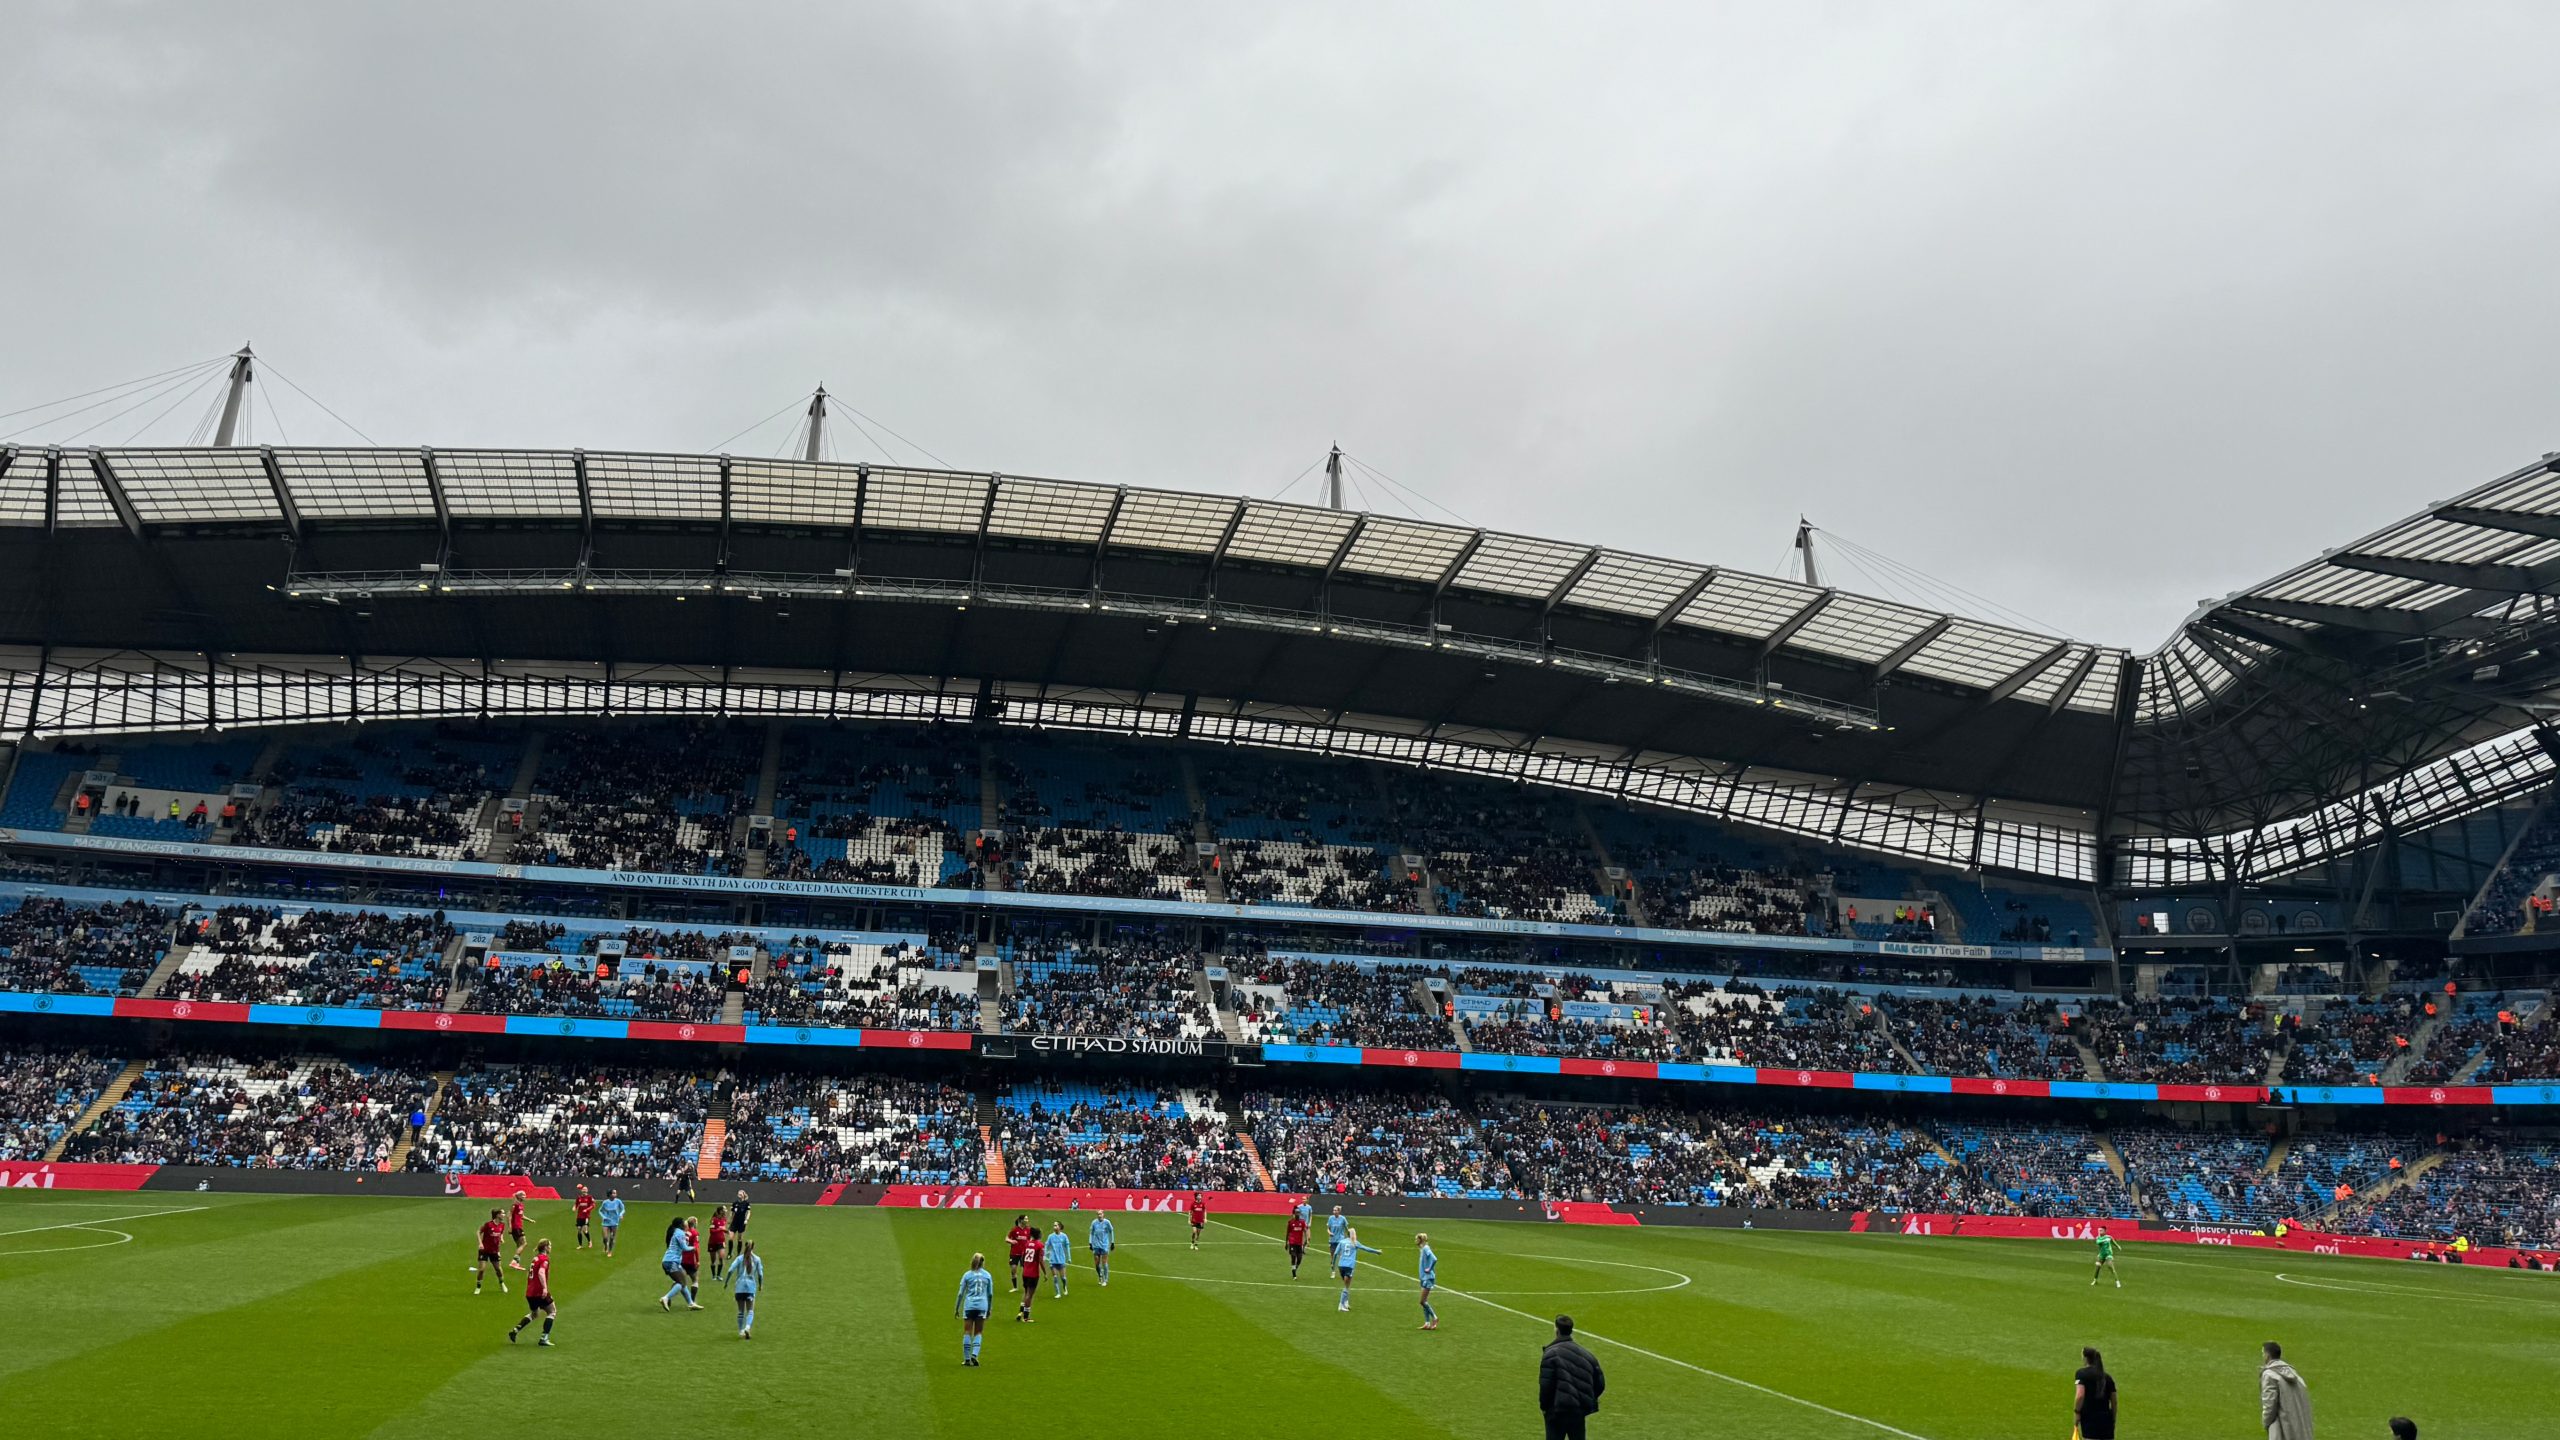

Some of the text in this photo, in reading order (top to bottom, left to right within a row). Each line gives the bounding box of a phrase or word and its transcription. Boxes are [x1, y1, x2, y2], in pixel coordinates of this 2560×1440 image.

[73, 837, 184, 854] MADE IN MANCHESTER
[209, 848, 269, 861] IMPECCABLE
[271, 852, 313, 863] SUPPORT
[315, 855, 345, 865] SINCE
[391, 860, 455, 872] LIVE FOR CITY
[610, 873, 927, 898] AND ON THE SIXTH DAY GOD CREATED MANCHESTER CITY
[1250, 908, 1276, 916] SHEIKH
[1312, 911, 1359, 921] MANCHESTER
[1359, 914, 1387, 922] THANKS
[1388, 915, 1403, 923] YOU
[1427, 918, 1450, 926] GREAT
[1450, 919, 1473, 927] YEARS
[472, 936, 487, 944] 202
[1662, 929, 1674, 937] The
[1788, 937, 1829, 946] Manchester
[1883, 942, 1986, 957] MAN CITY True Faith
[497, 955, 532, 963] TIHAD
[1429, 980, 1441, 988] 207
[1031, 1036, 1203, 1055] ETIHAD STADIUM
[1024, 1248, 1036, 1263] 23
